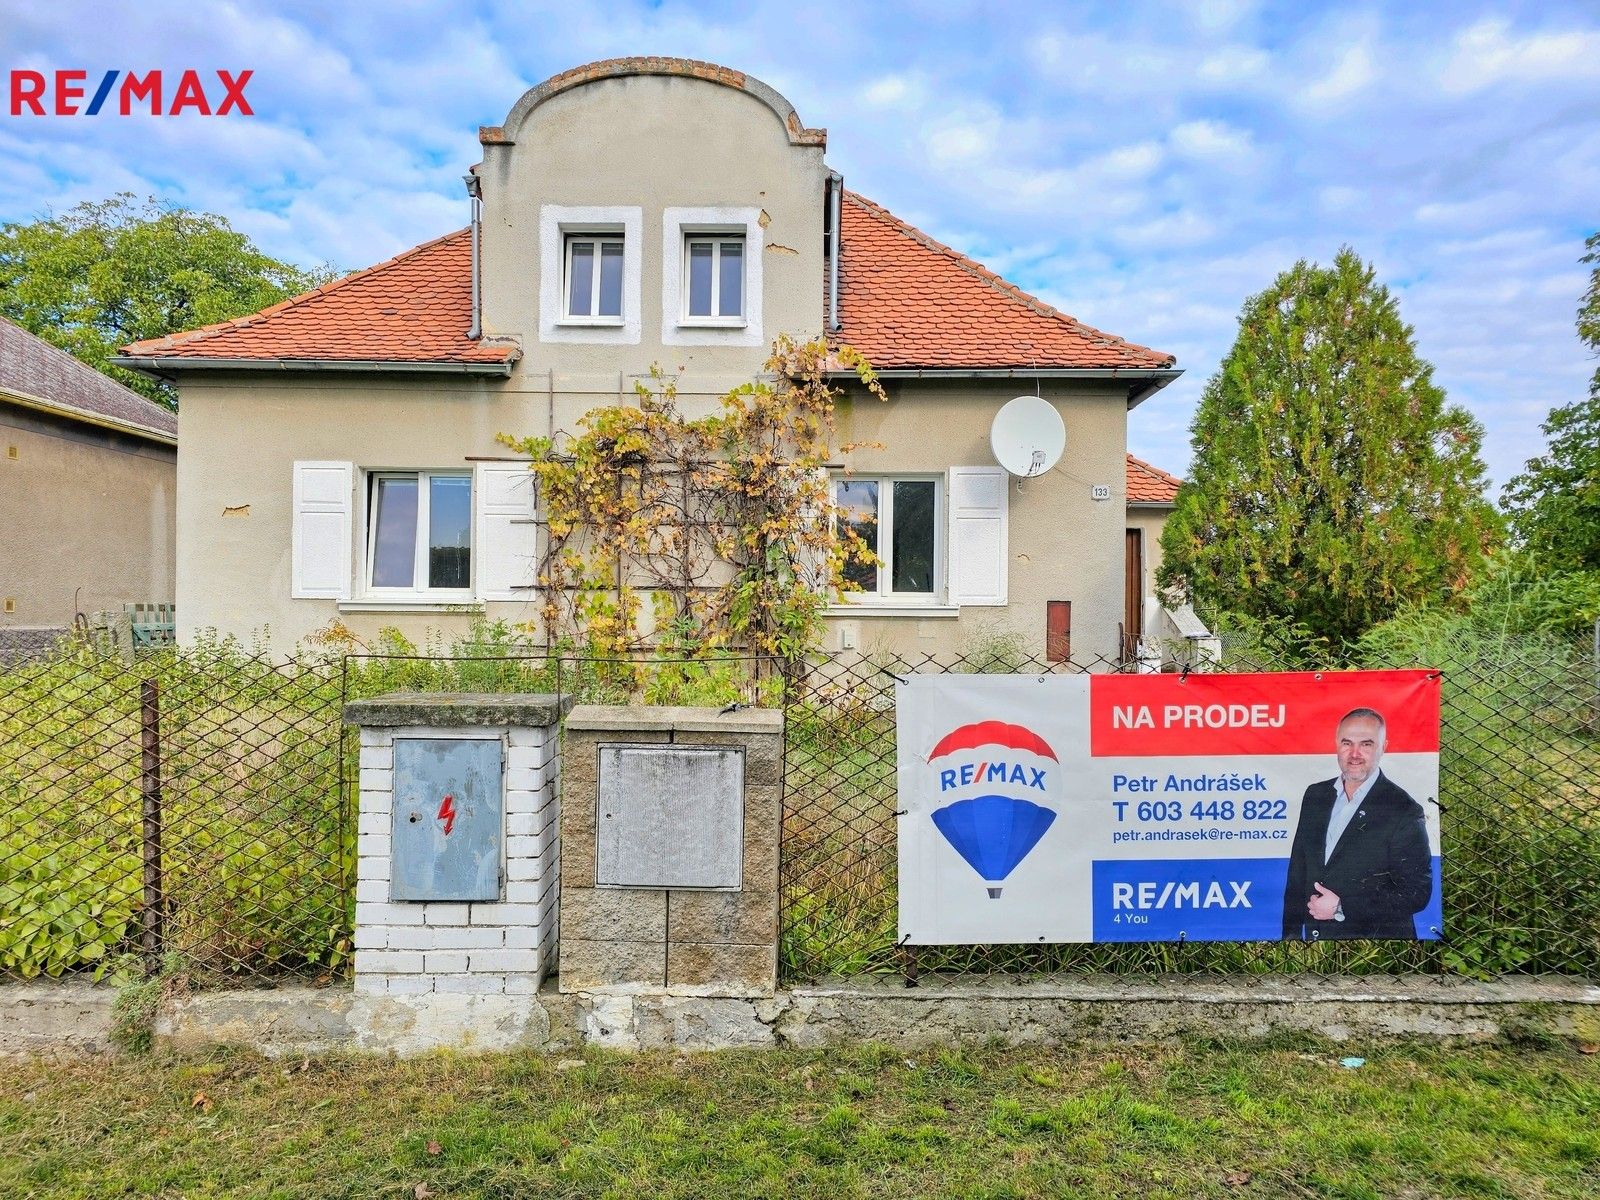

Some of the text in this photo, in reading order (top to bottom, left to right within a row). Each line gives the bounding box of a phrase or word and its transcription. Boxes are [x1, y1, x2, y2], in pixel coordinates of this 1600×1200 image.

[1094, 488, 1108, 496] 133
[1113, 704, 1286, 729] NA PRODEJ
[940, 762, 1047, 792] RE/MAX
[1113, 773, 1267, 792] Petr Andrášek
[1112, 800, 1287, 822] T 603 448 822
[1113, 828, 1288, 844] petr.andrasek@re-max.cz
[1112, 881, 1253, 910] RE/MAX
[1113, 913, 1149, 924] 4 You
